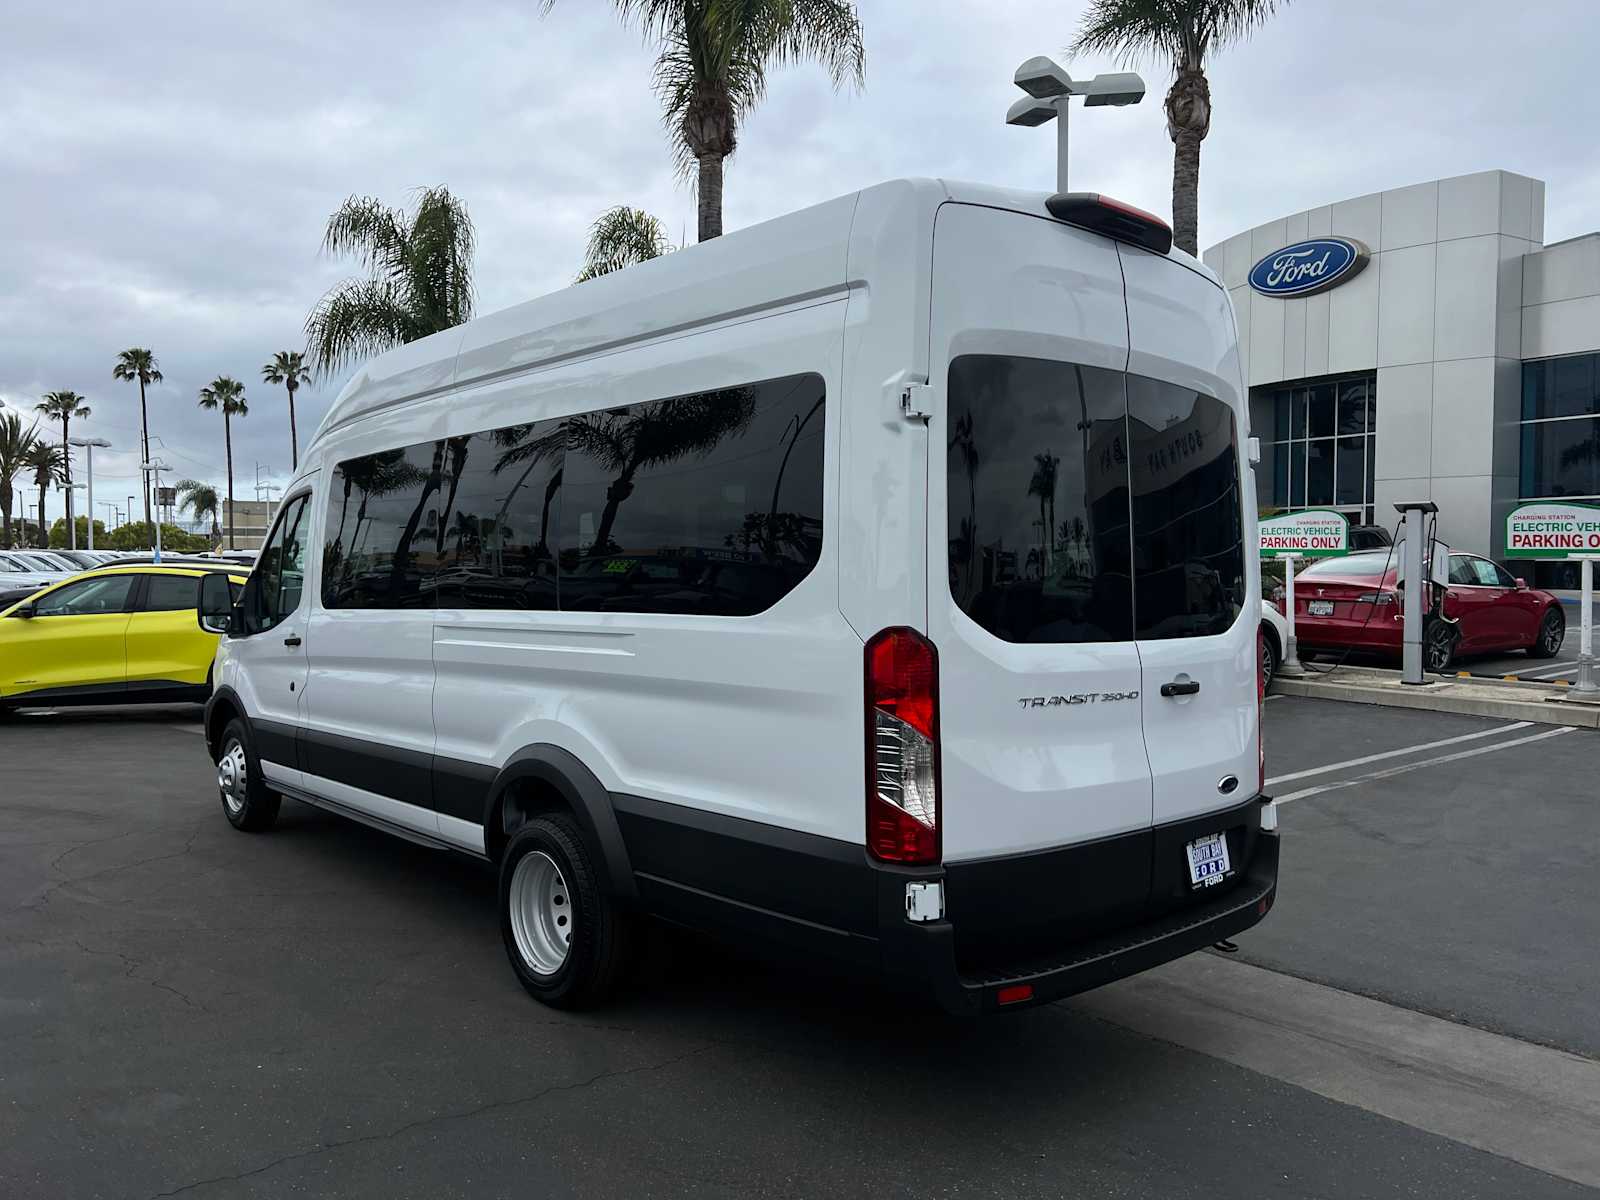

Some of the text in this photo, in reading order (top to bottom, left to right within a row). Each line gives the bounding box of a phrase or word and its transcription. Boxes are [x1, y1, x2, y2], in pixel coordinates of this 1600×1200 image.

[1266, 248, 1332, 286] Ford
[1261, 527, 1341, 536] ELECTRIC VEHICLE
[1513, 522, 1574, 532] ELECTRIC
[1260, 536, 1341, 548] PARKING ONLY
[1512, 534, 1584, 548] PARKING
[1018, 693, 1099, 709] TRANSIT
[1193, 845, 1211, 863] SOUTH
[1210, 839, 1224, 857] BAY
[1195, 859, 1225, 880] FORD
[1204, 873, 1224, 888] FORD
